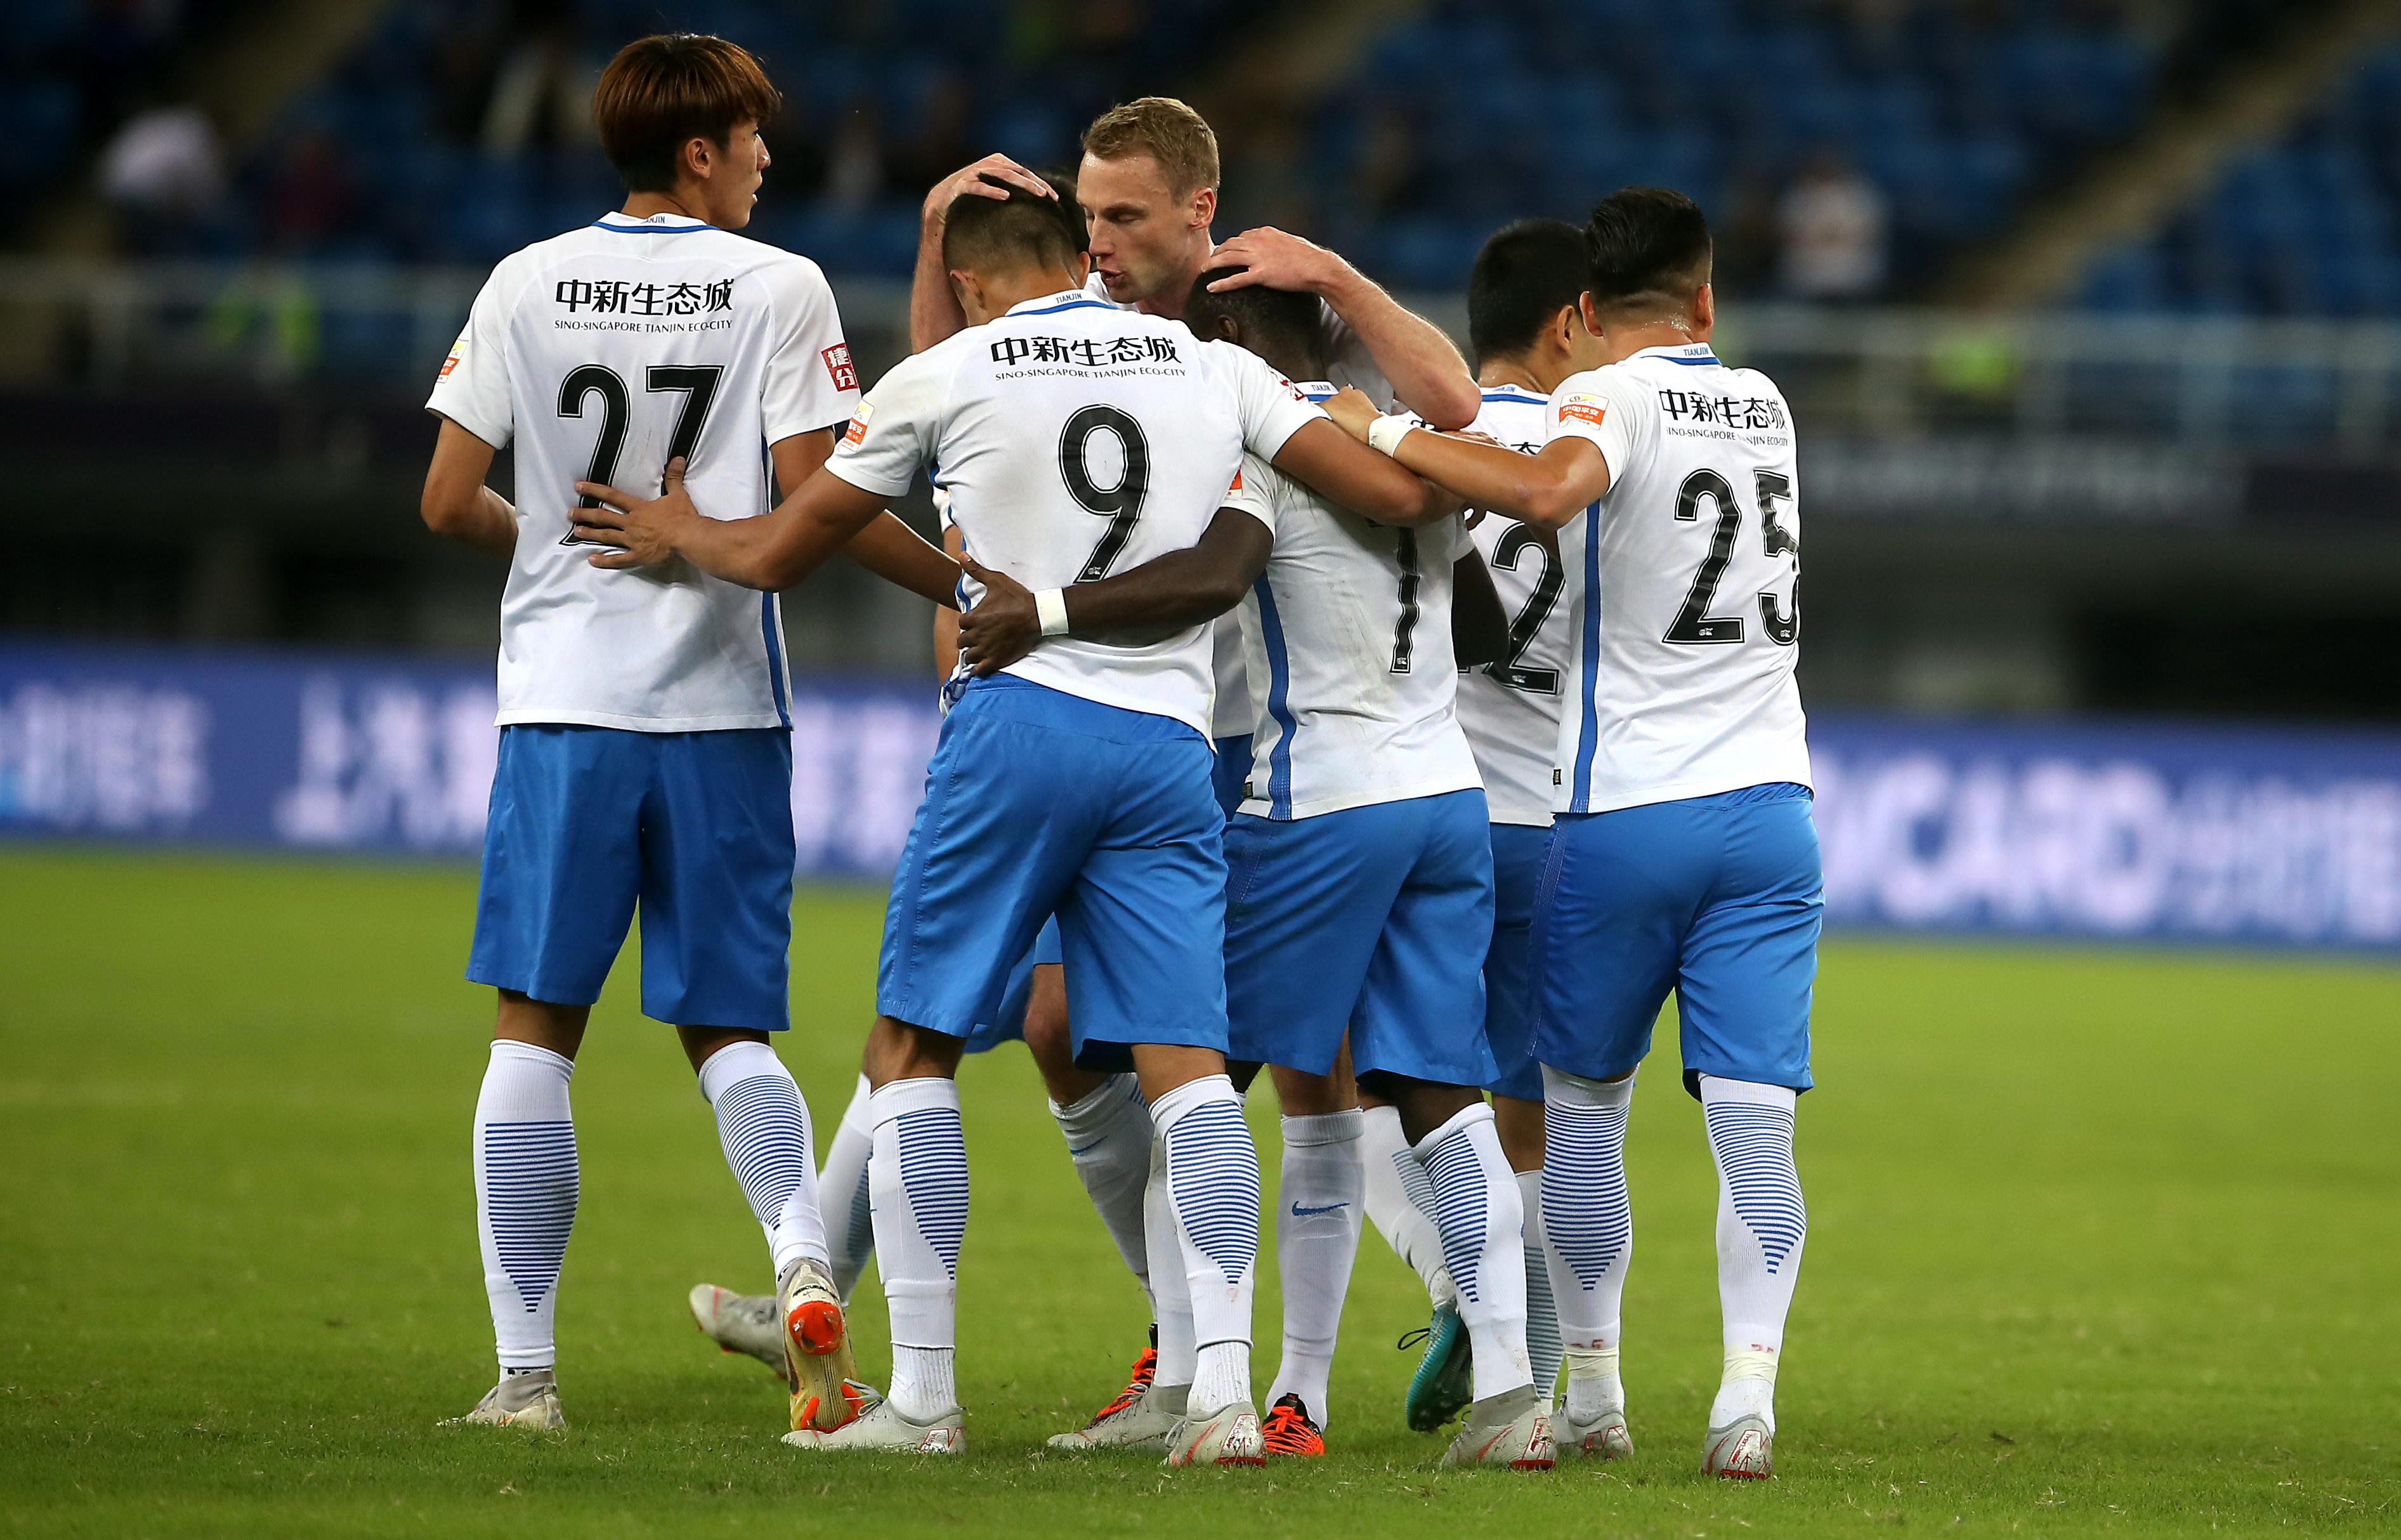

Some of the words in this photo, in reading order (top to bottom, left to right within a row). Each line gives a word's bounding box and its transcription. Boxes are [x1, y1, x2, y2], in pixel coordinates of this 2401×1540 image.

[556, 278, 735, 316] 中新生态城
[1055, 292, 1083, 304] TIANJIN
[554, 320, 641, 332] SINO-SINGAPORE
[645, 323, 685, 334] TIANJIN
[688, 320, 733, 332] ECO-CITY
[990, 336, 1182, 367] 中新生态城
[1683, 347, 1709, 356] TIANJIN
[995, 367, 1090, 381] SINO-SINGAPORE
[1092, 367, 1136, 378] TIANJIN
[1140, 367, 1186, 376] ECO-CITY
[1659, 389, 1788, 430] 中新生态城
[557, 363, 727, 546] 27
[1058, 403, 1151, 584] 9
[1661, 468, 1801, 646] 25
[1458, 521, 1567, 695] 2
